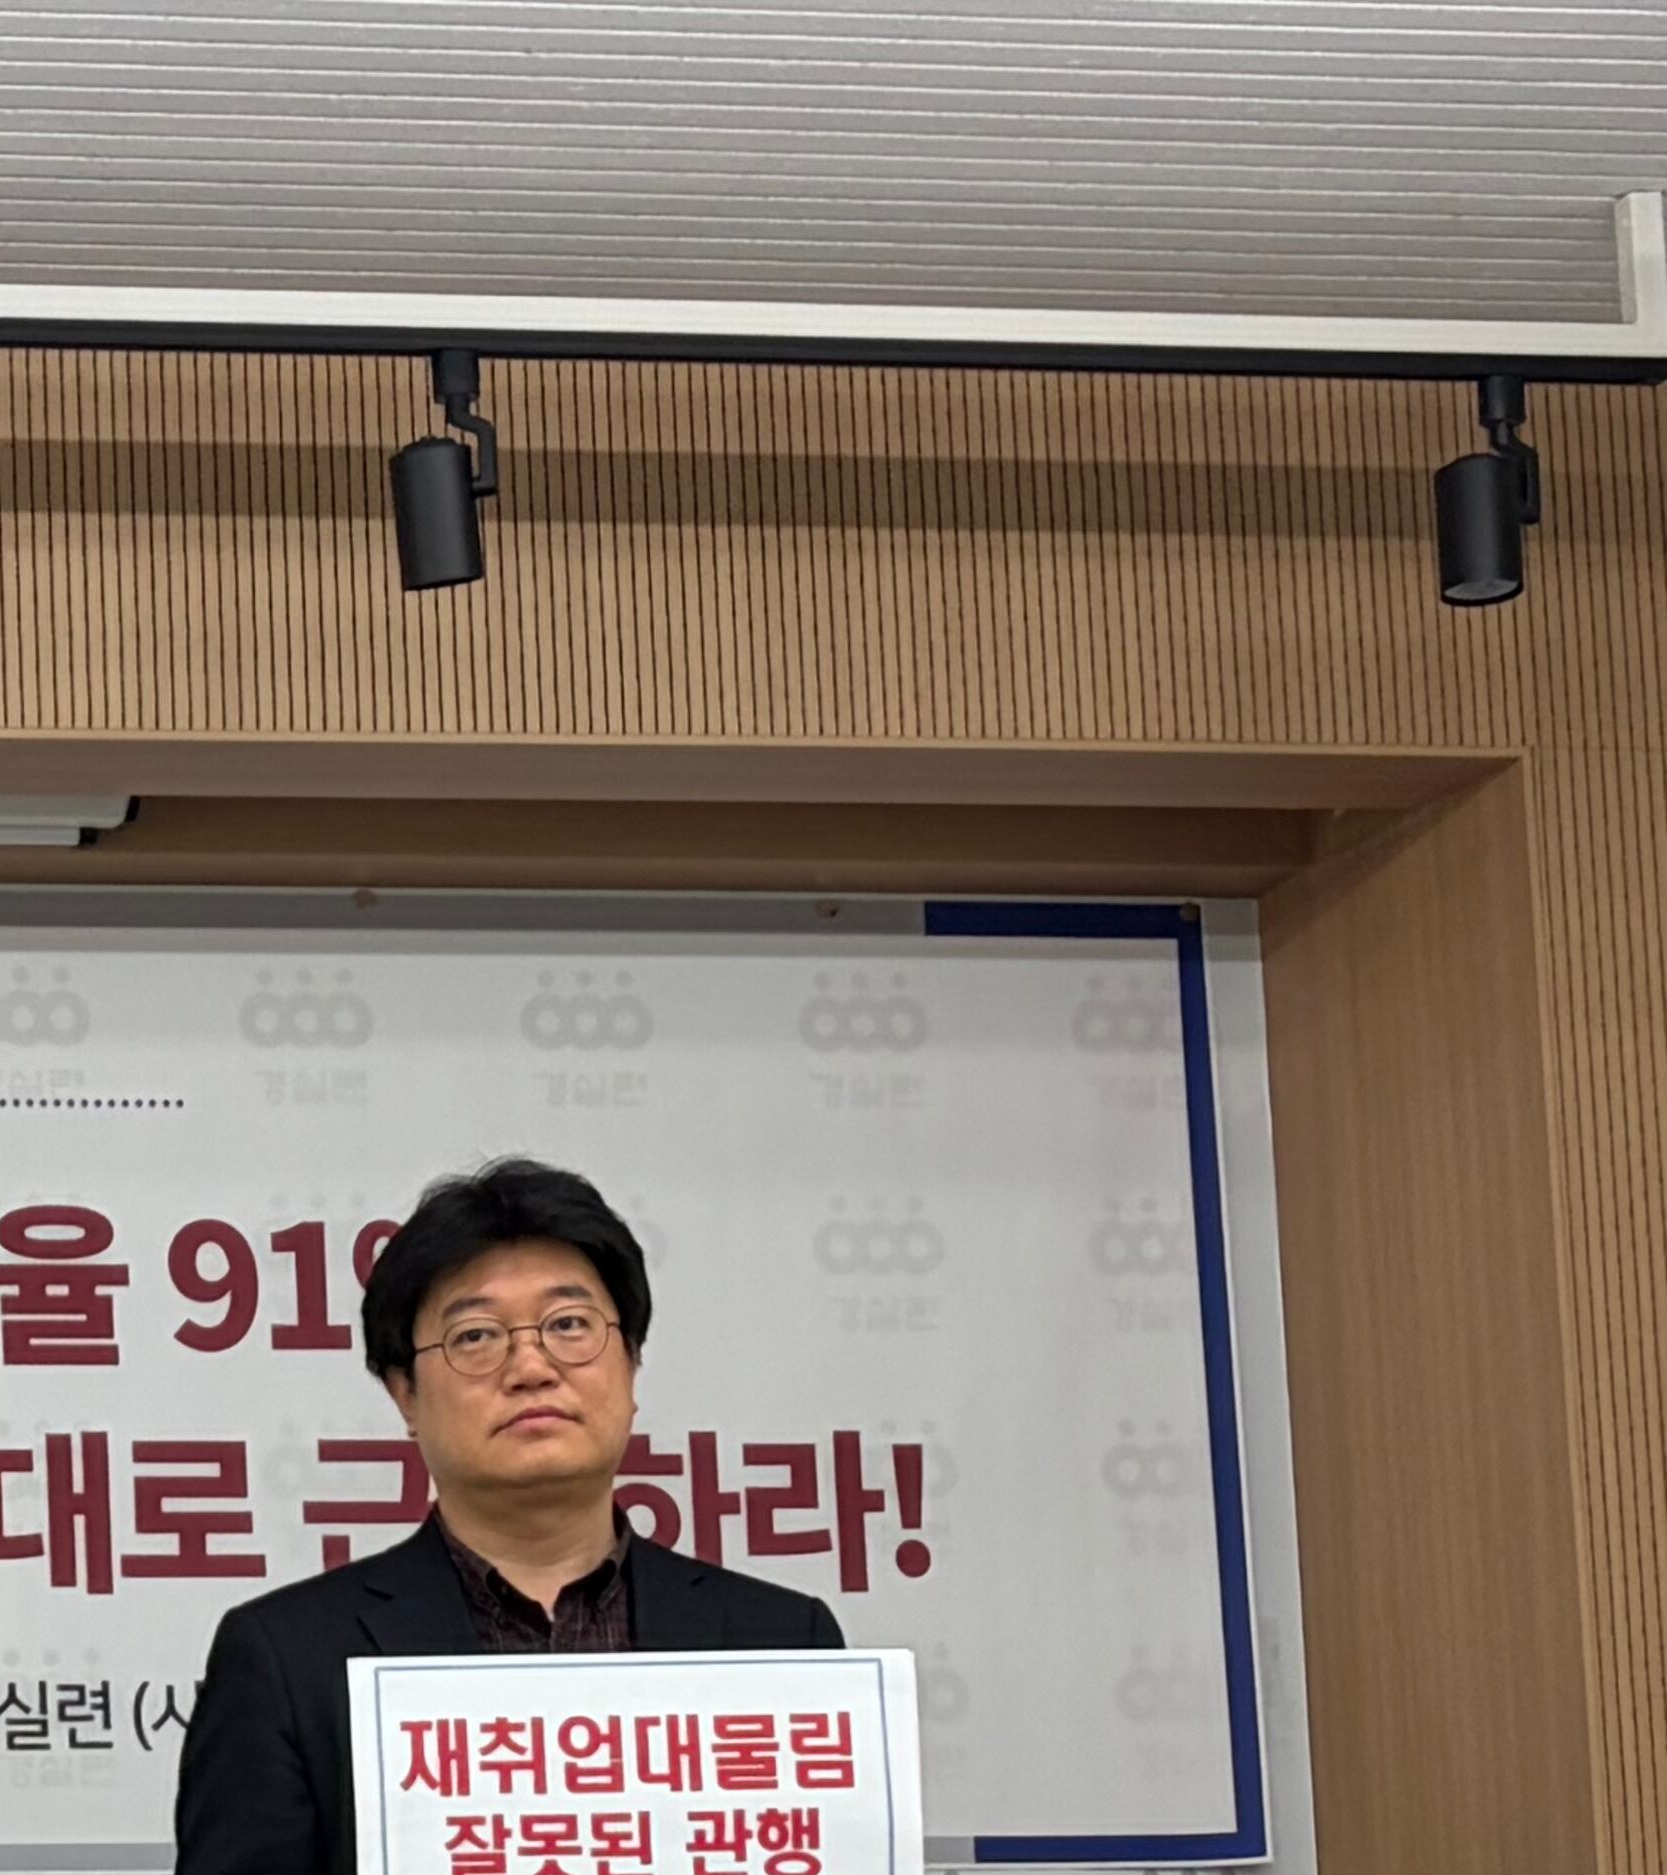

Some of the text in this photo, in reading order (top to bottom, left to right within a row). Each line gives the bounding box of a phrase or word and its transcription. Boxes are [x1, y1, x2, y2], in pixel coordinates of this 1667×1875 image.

[168, 1218, 403, 1353] 91
[302, 1430, 932, 1594] 근하라!
[399, 1710, 856, 1798] 재취업대물림
